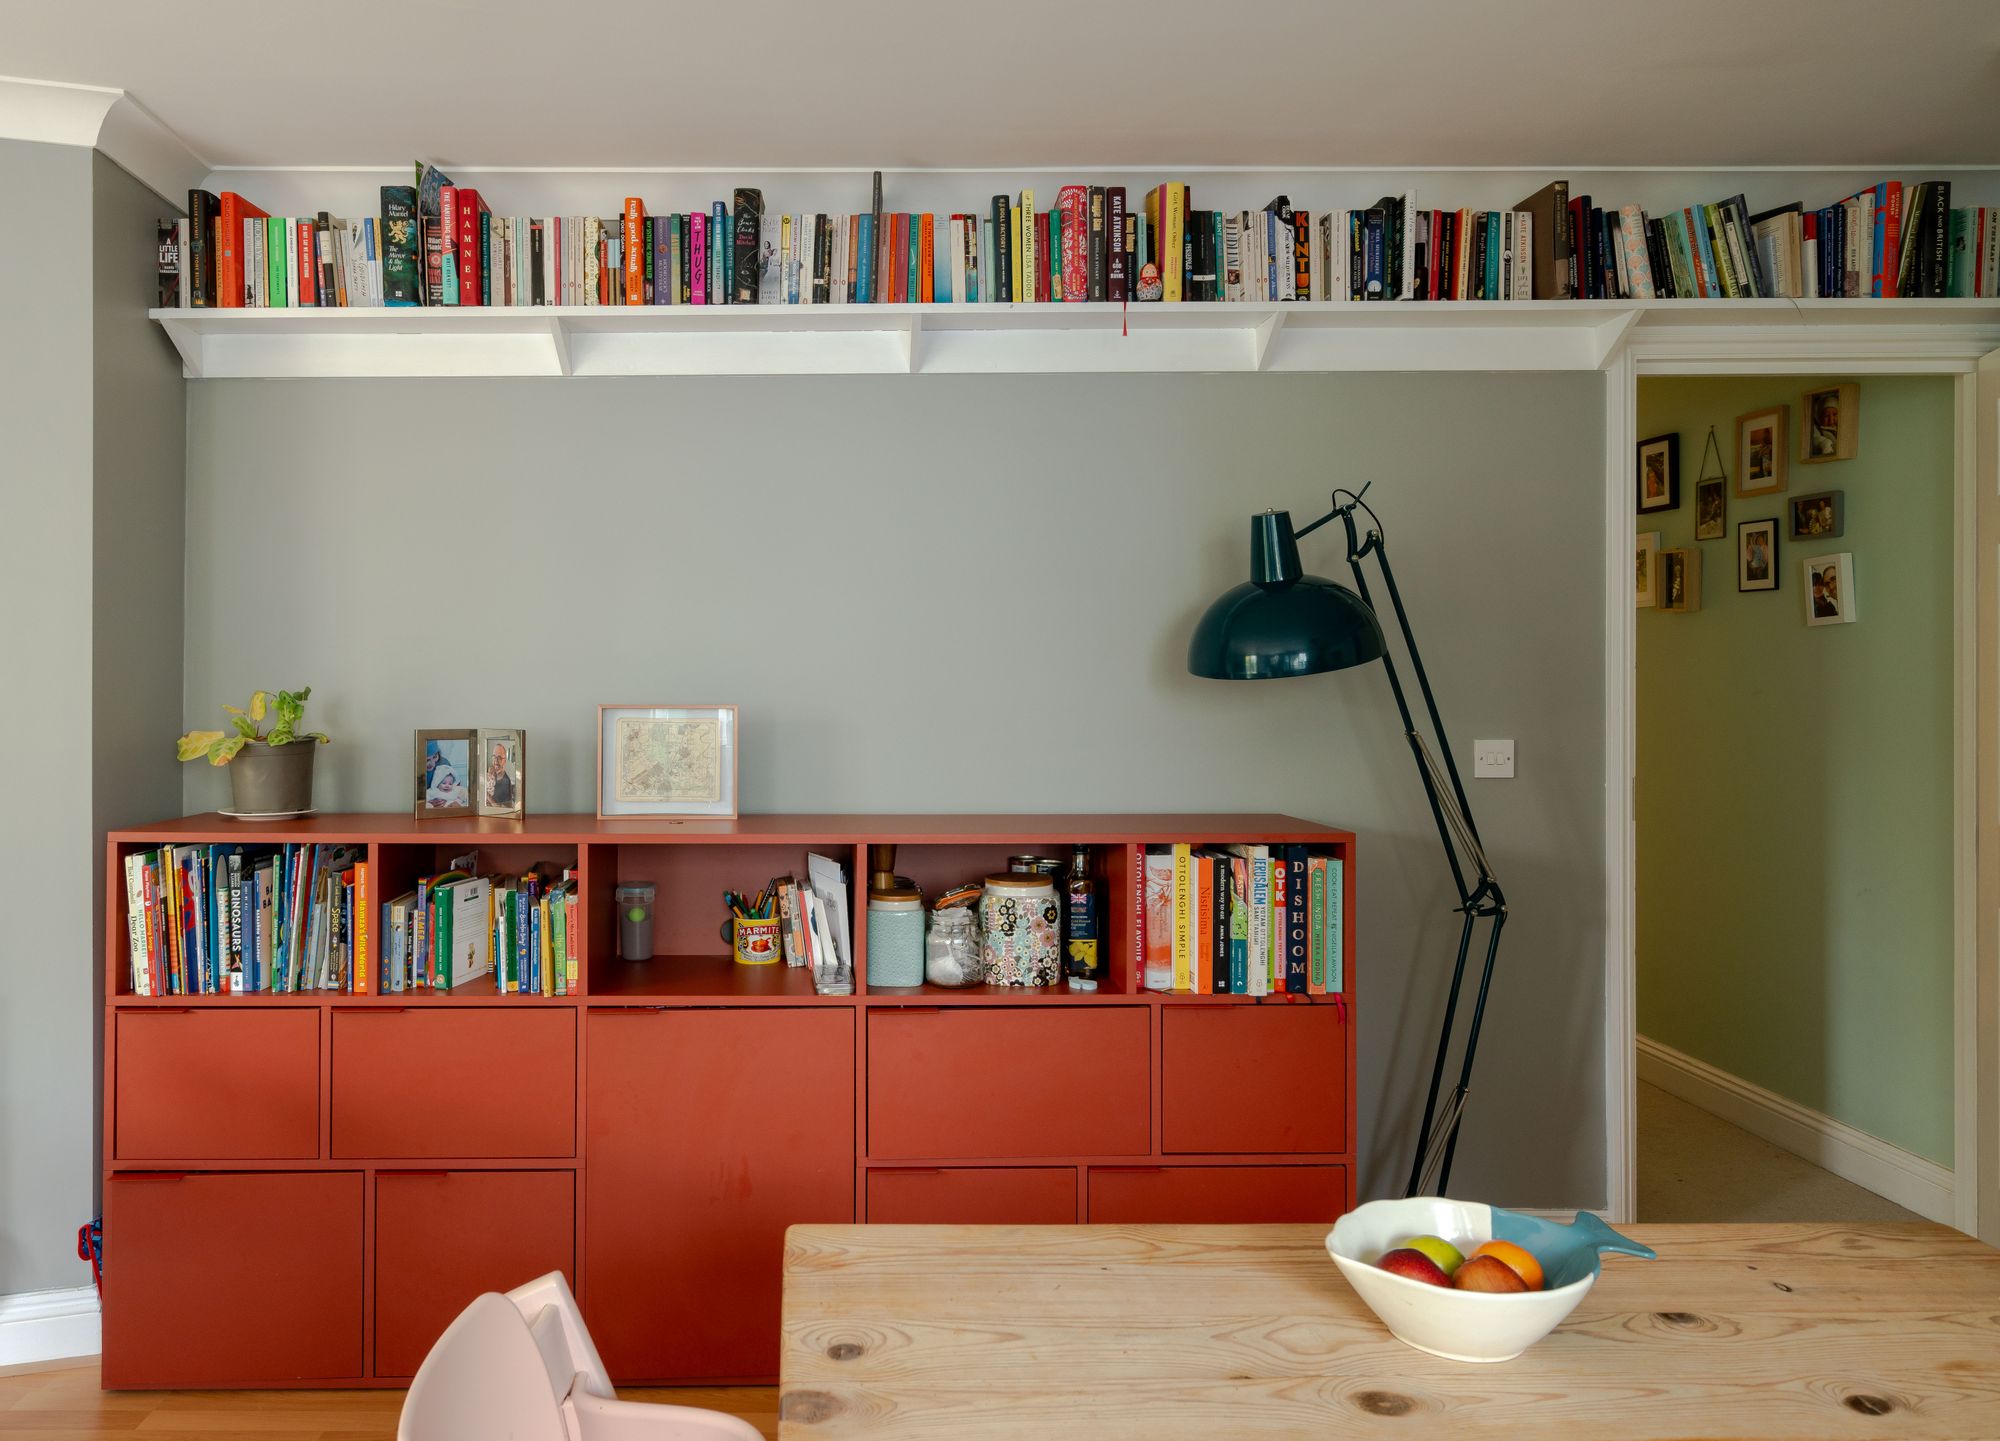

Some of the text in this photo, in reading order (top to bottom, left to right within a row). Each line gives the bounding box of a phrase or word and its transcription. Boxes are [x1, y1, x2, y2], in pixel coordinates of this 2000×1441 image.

[630, 200, 639, 220] really
[1992, 212, 1997, 223] ON
[1113, 196, 1121, 252] KATE ATKINSON
[160, 253, 178, 263] LIFE
[463, 207, 471, 289] HAMNET
[629, 246, 639, 273] actually
[231, 890, 241, 951] DINOSAURS
[332, 908, 340, 932] Space
[1199, 887, 1210, 935] Nistisima
[1291, 861, 1305, 973] DISHOOM
[359, 935, 367, 952] Wild
[739, 926, 779, 936] MARMITE
